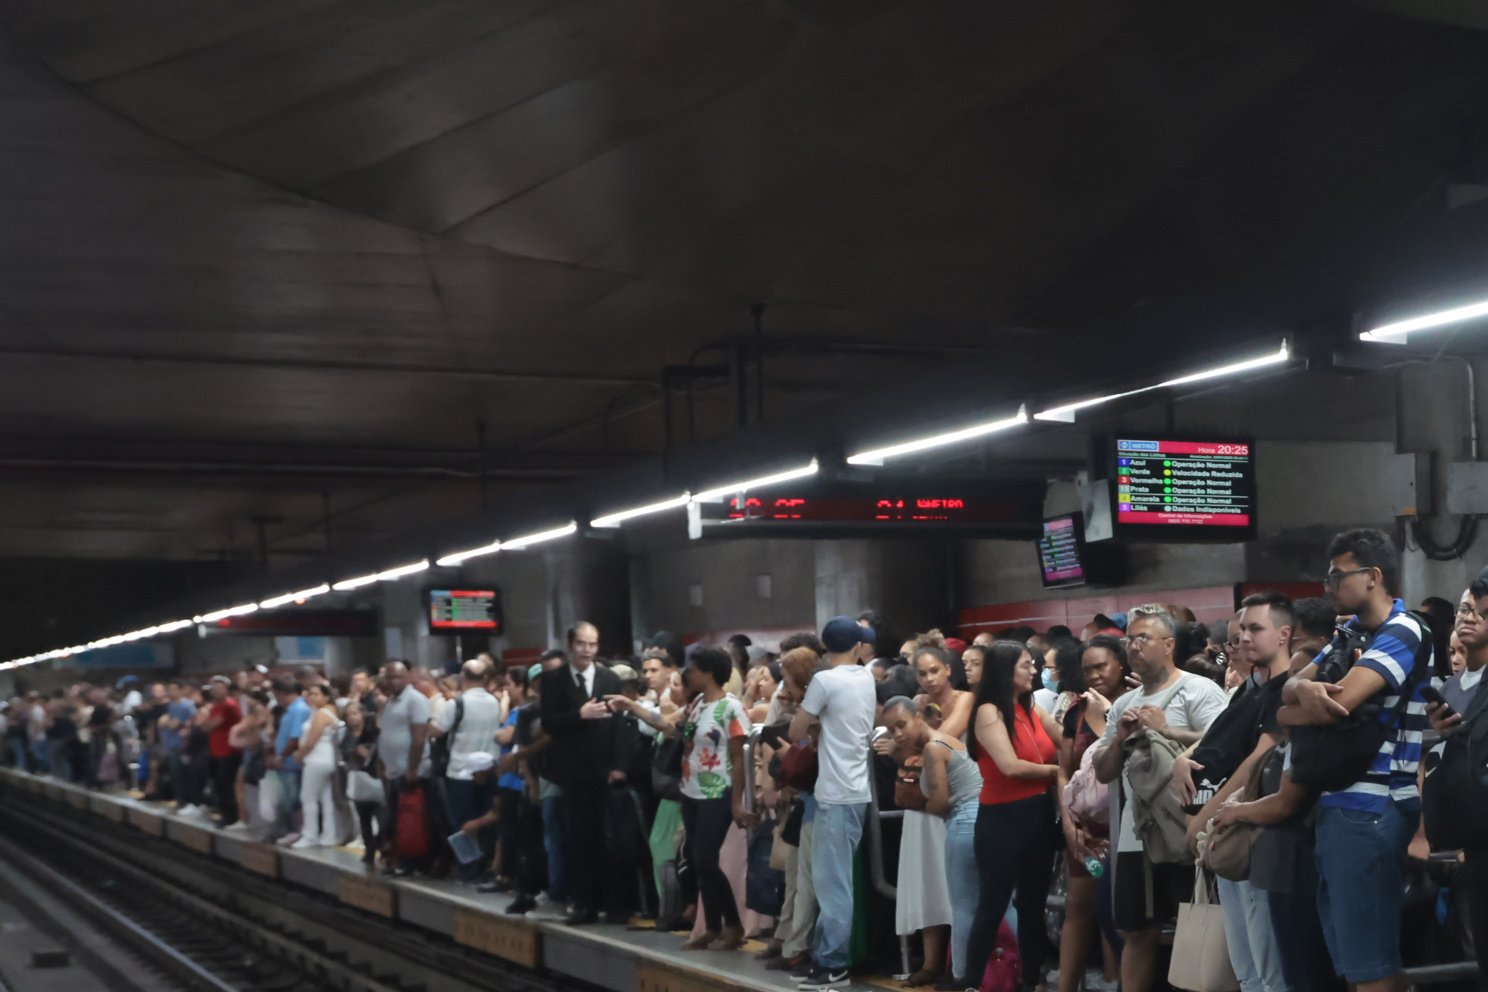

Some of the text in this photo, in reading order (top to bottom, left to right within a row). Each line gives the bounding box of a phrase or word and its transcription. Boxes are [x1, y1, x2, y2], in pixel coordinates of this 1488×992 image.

[1218, 445, 1248, 455] 20:25
[1172, 460, 1205, 469] Operação
[1172, 469, 1210, 477] Velocidade
[1172, 479, 1205, 487] Operação
[1172, 487, 1205, 495] Operação
[1172, 496, 1205, 504] Operação
